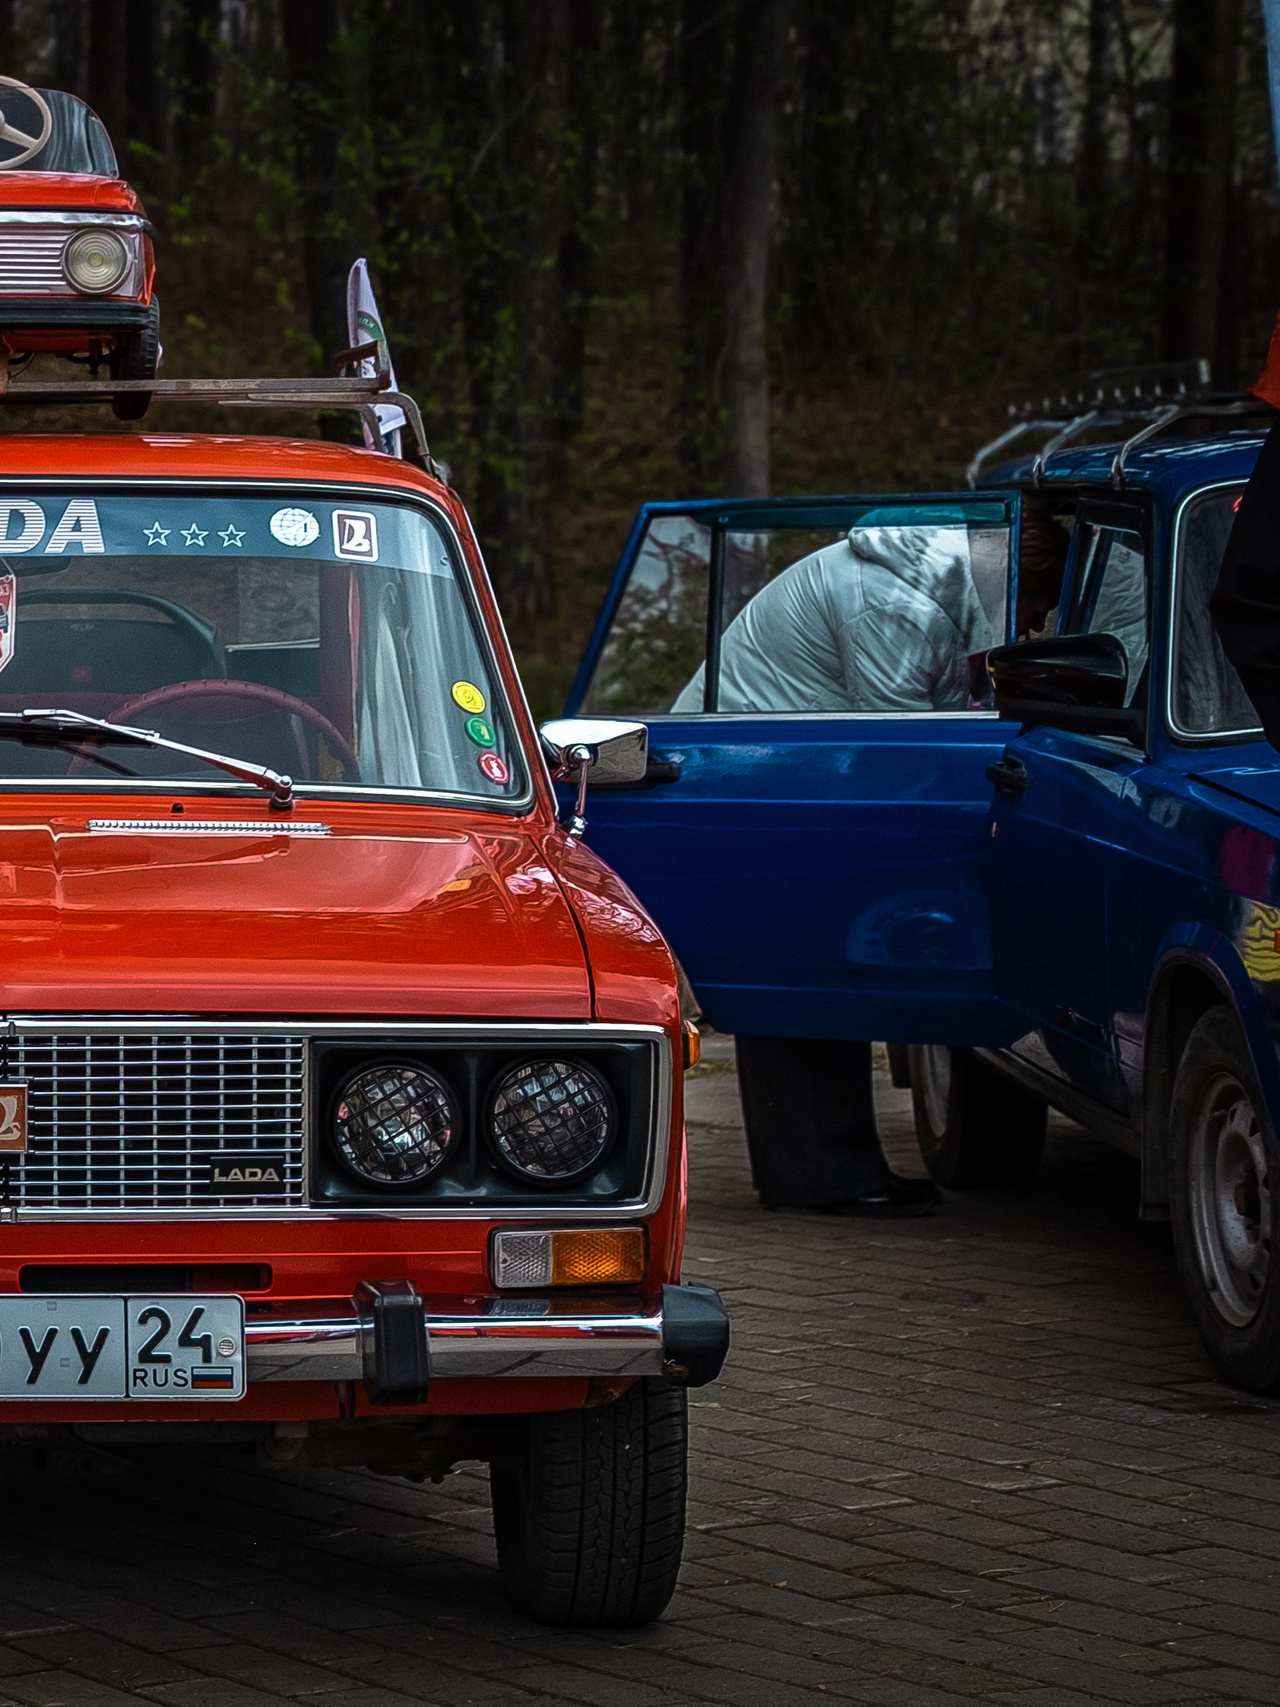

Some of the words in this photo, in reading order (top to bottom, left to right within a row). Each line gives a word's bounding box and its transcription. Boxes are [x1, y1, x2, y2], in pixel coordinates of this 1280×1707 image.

[213, 1167, 280, 1183] LADA
[137, 1305, 213, 1364] 24
[132, 1367, 189, 1388] RUS
